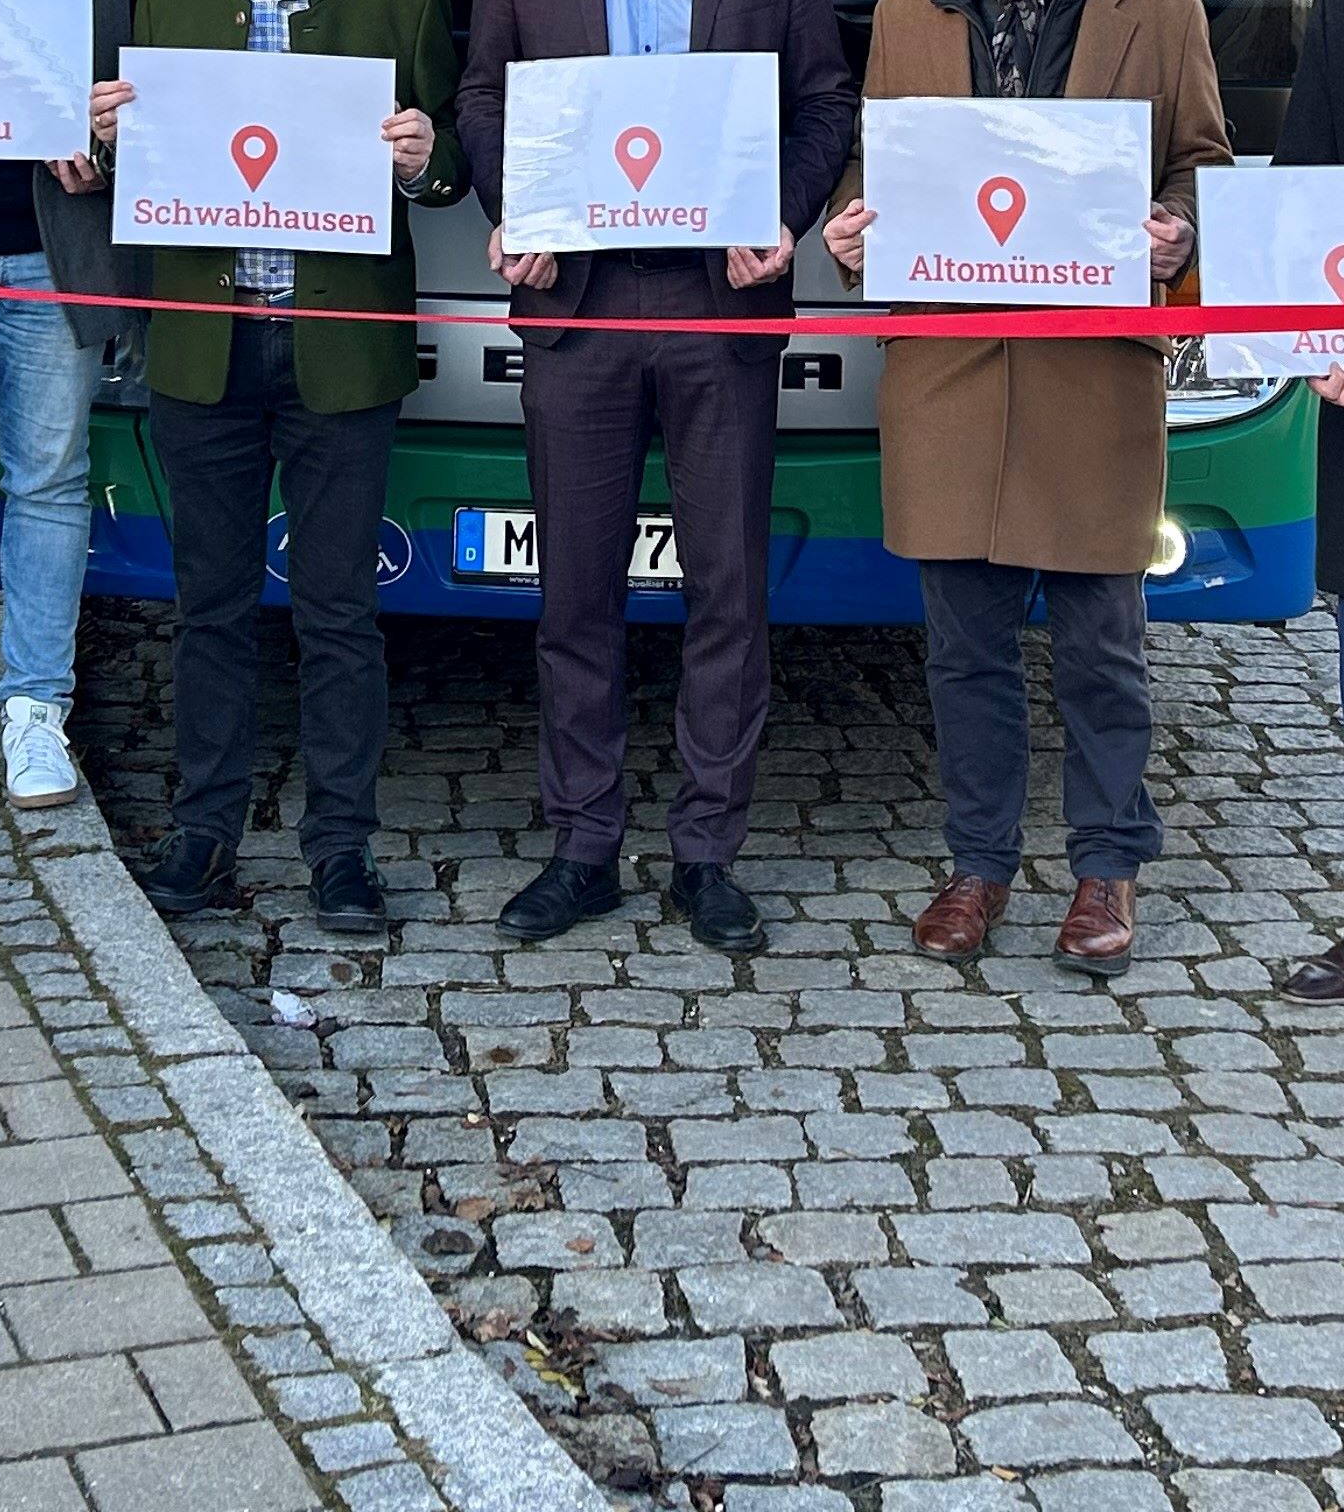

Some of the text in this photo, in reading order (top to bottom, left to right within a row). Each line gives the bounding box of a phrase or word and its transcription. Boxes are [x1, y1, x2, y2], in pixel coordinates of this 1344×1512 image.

[133, 198, 376, 234] Schwabhausen
[587, 200, 708, 232] Erdweg
[908, 254, 1115, 285] Altomünster
[465, 548, 476, 561] D
[504, 520, 534, 566] M
